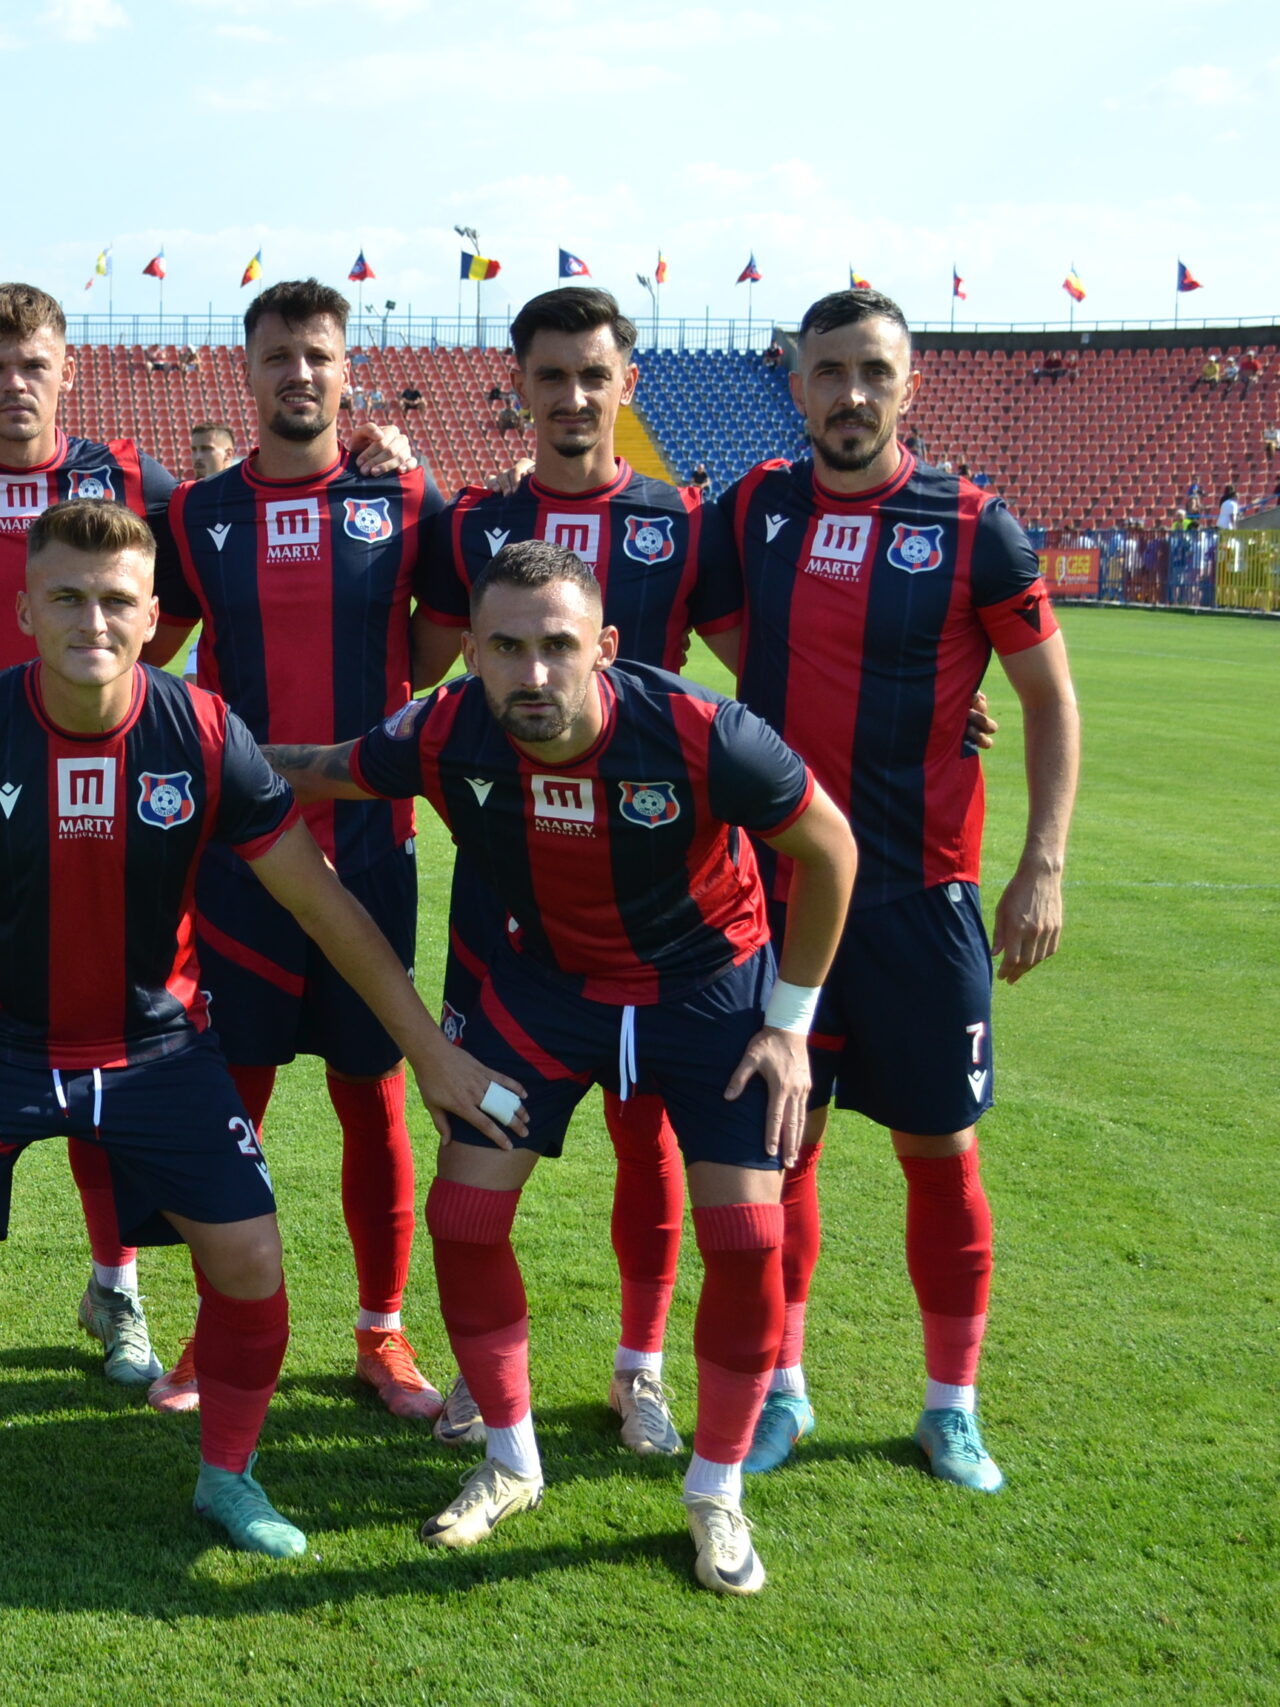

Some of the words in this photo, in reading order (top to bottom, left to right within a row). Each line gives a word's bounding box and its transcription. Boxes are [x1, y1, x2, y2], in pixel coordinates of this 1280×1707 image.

[266, 544, 320, 559] MARTY
[806, 558, 862, 576] MARTY
[58, 818, 114, 834] MARTY
[535, 818, 595, 834] MARTY
[965, 1021, 985, 1064] 7
